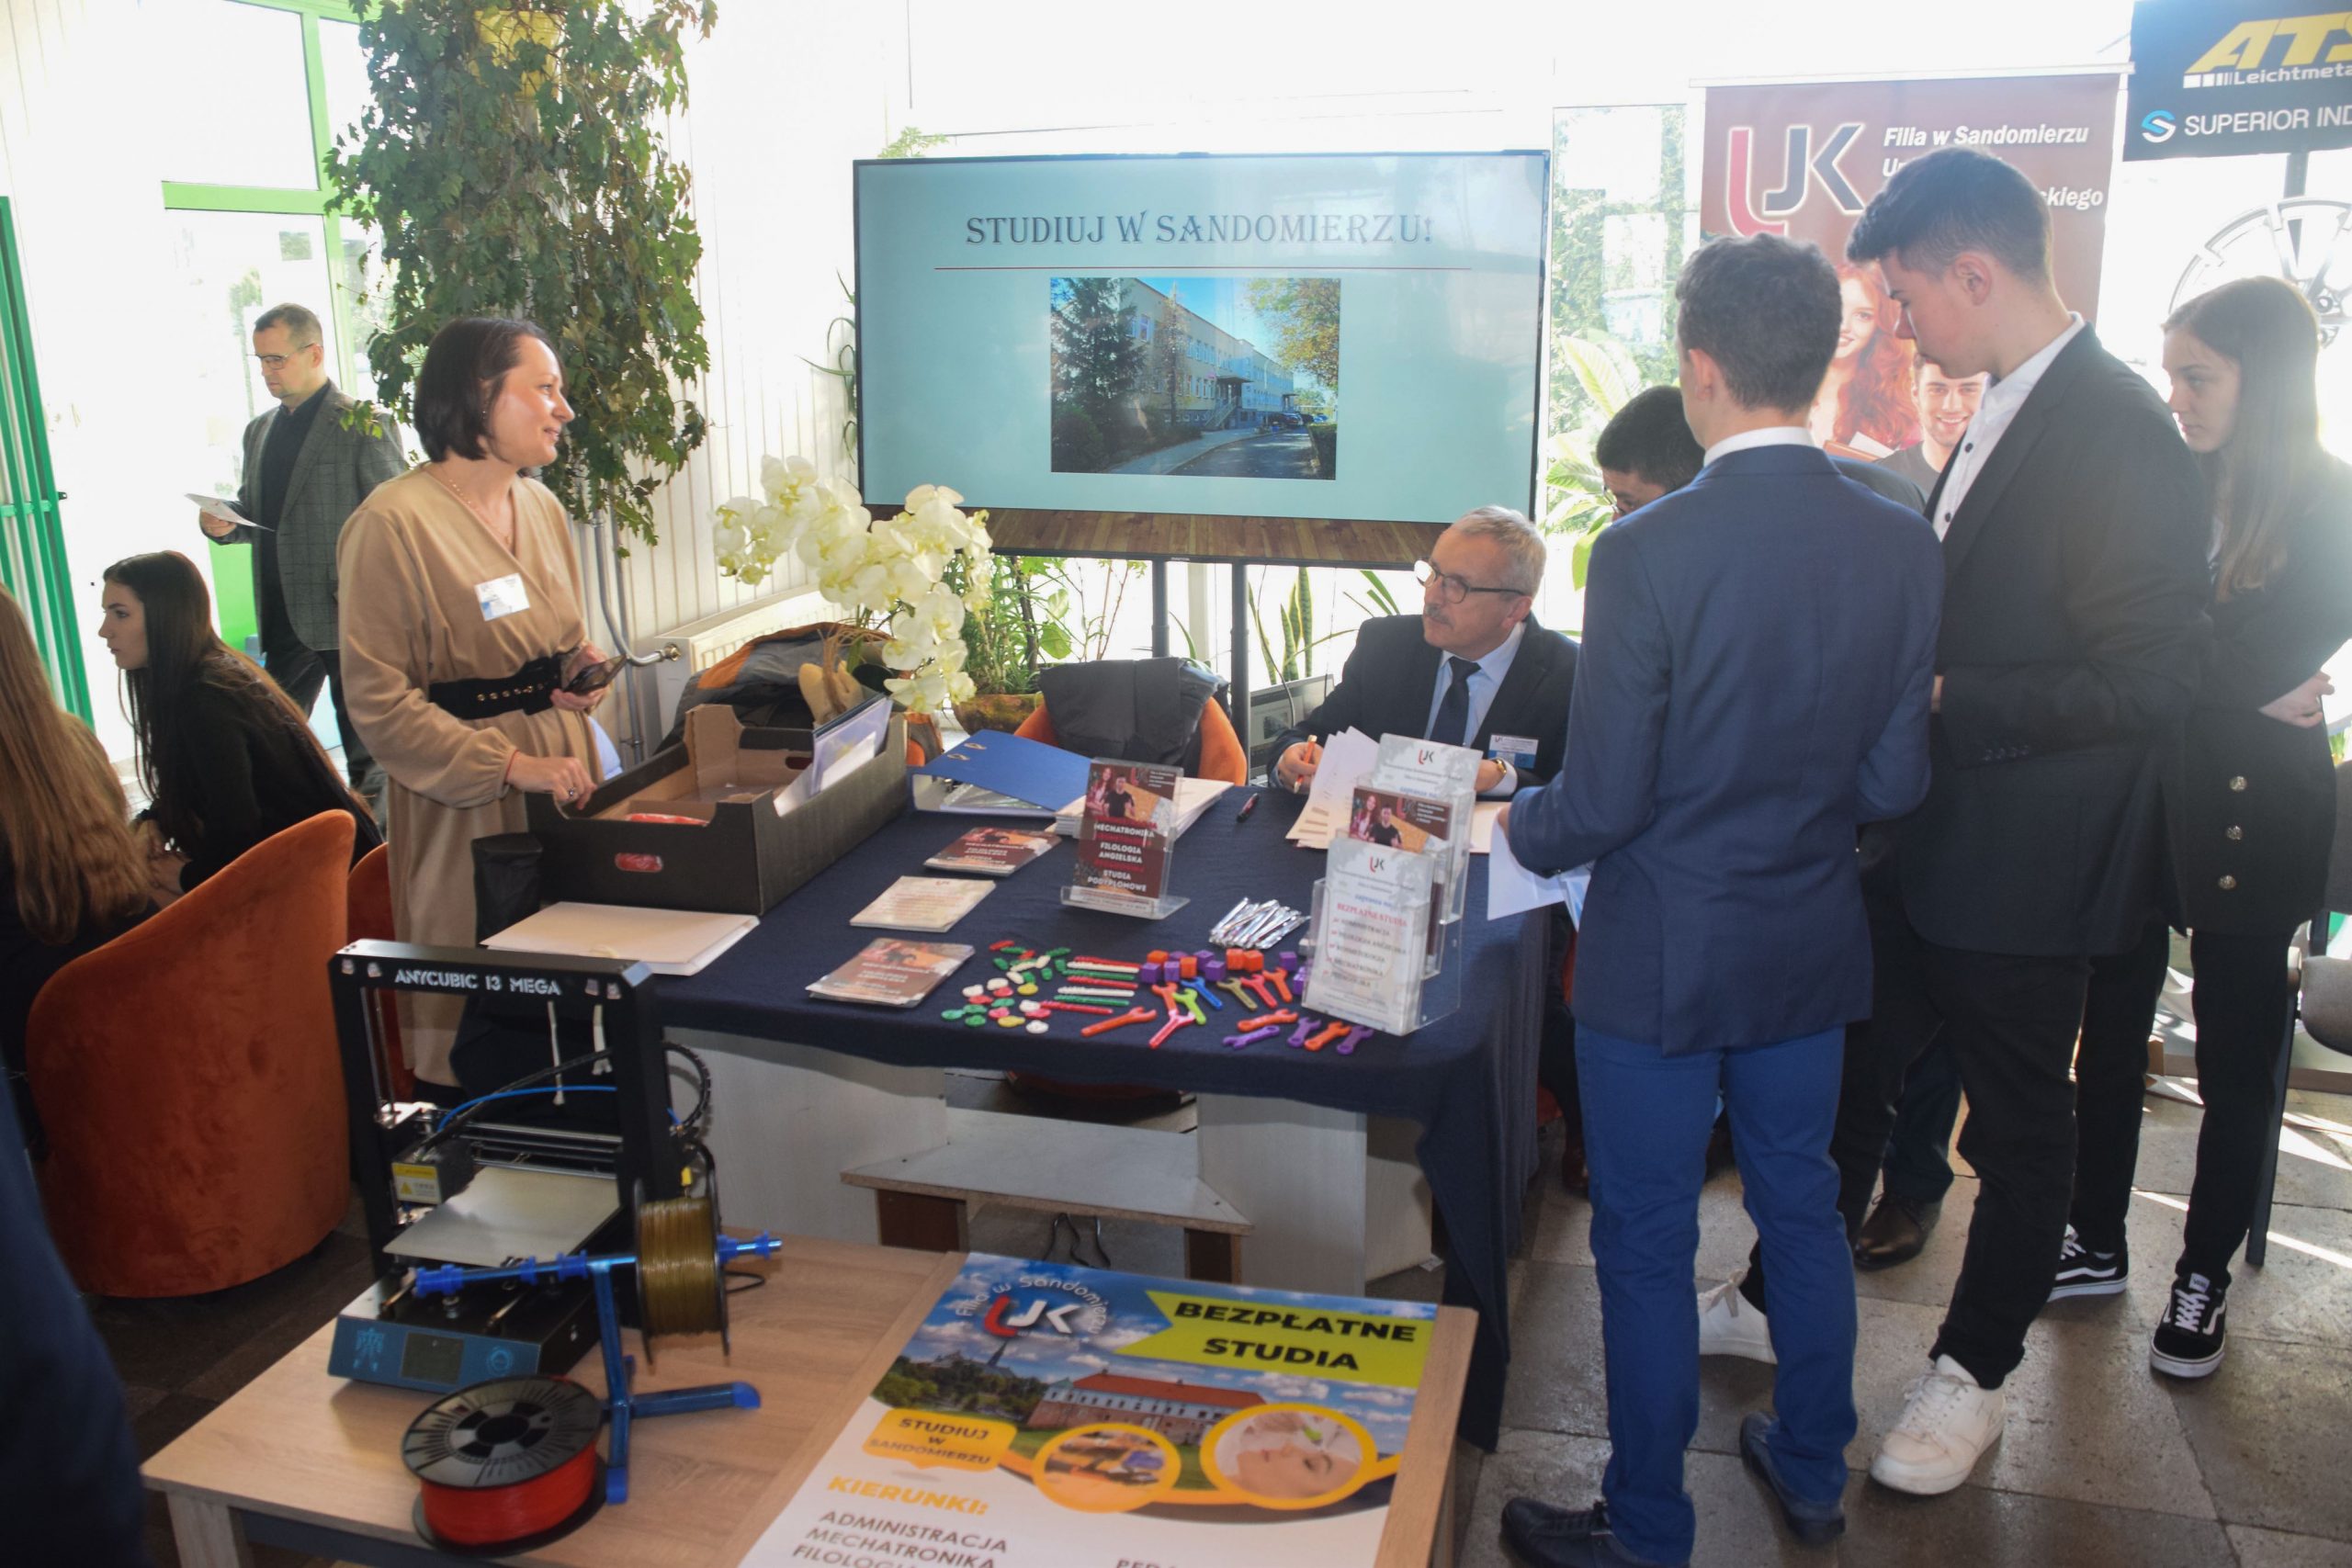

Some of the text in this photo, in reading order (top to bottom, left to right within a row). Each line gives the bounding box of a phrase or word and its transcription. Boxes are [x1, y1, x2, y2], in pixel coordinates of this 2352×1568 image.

[1883, 123, 2088, 146] Filia w Sandomierzu
[2184, 107, 2310, 136] SUPERIOR
[965, 209, 1435, 245] STUDIUJ W SANDOMIERZU!
[1100, 841, 1142, 855] FILOLOGIA
[1102, 869, 1132, 881] STUDIA
[394, 969, 479, 989] ANYCUBIC
[509, 976, 562, 996] MEGA
[1174, 1301, 1417, 1342] BEZPŁATNE
[1202, 1337, 1360, 1371] STUDIA
[899, 1417, 990, 1440] STUDIUJ
[928, 1436, 946, 1446] W
[868, 1438, 991, 1465] SANDOMIERZU
[826, 1474, 990, 1517] KIERUNKI:
[818, 1510, 1008, 1554] ADMINISTRACJA
[792, 1544, 919, 1568] FILOLOG
[805, 1528, 996, 1568] MECHATRONIKA
